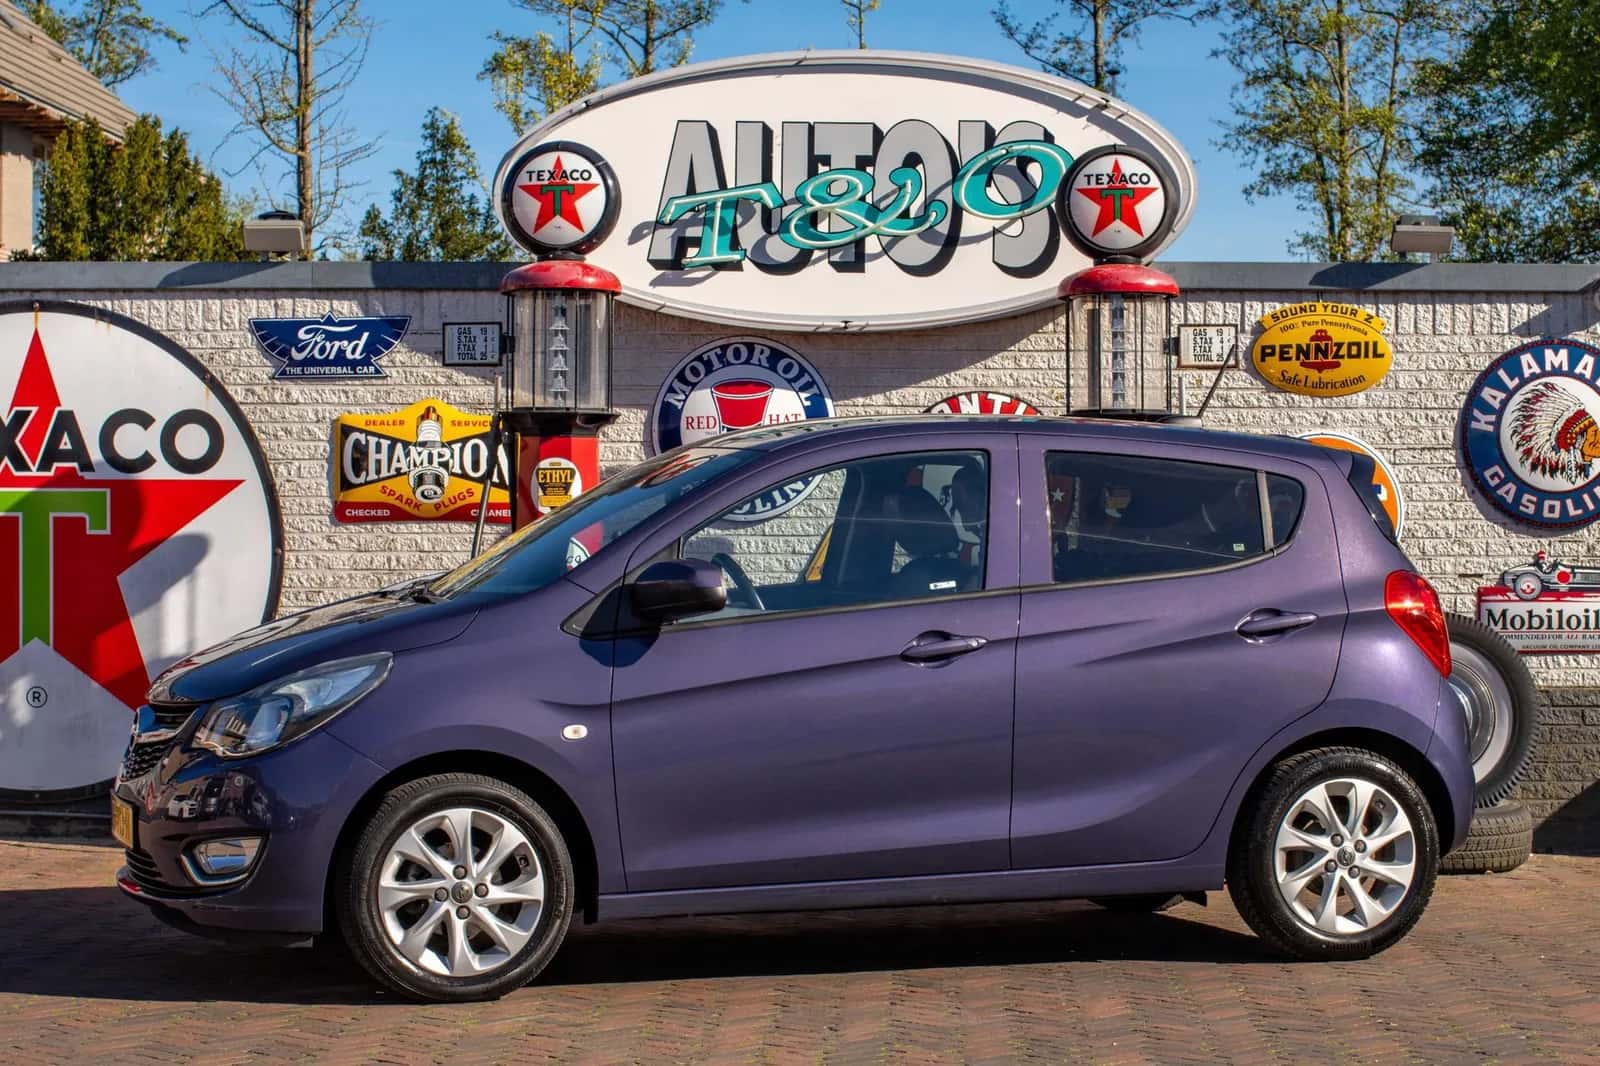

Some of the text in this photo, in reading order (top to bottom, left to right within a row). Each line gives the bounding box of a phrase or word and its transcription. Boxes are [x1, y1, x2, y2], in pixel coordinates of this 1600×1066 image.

[526, 169, 592, 182] TEXACO
[1084, 173, 1151, 185] TEXACO
[648, 119, 1063, 277] AUTO'S
[657, 181, 785, 268] T
[952, 140, 1075, 220] O
[1271, 304, 1317, 322] SOUND
[1322, 304, 1358, 318] YOUR
[457, 327, 472, 336] GAS
[1192, 328, 1208, 337] GAS
[1216, 328, 1224, 336] 19
[1321, 319, 1368, 336] Pennsylvania
[290, 324, 370, 361] Ford
[457, 352, 479, 361] TOTAL
[1192, 353, 1224, 362] TOTAL 25
[1260, 341, 1385, 362] PENNZOIL
[285, 366, 376, 375] THE UNIVERSAL CAR
[664, 344, 822, 410] MOTOR OIL
[1281, 369, 1366, 389] Safe Lubrication
[1471, 348, 1600, 433] KALAMA
[364, 419, 492, 428] DEALER SERVIC
[685, 415, 717, 430] RED
[538, 469, 573, 483] ETHYL
[379, 484, 475, 513] SPARK PLUGS
[733, 476, 814, 513] LIN
[345, 508, 511, 517] CHECKED CANE
[1485, 608, 1600, 631] Mobiloil
